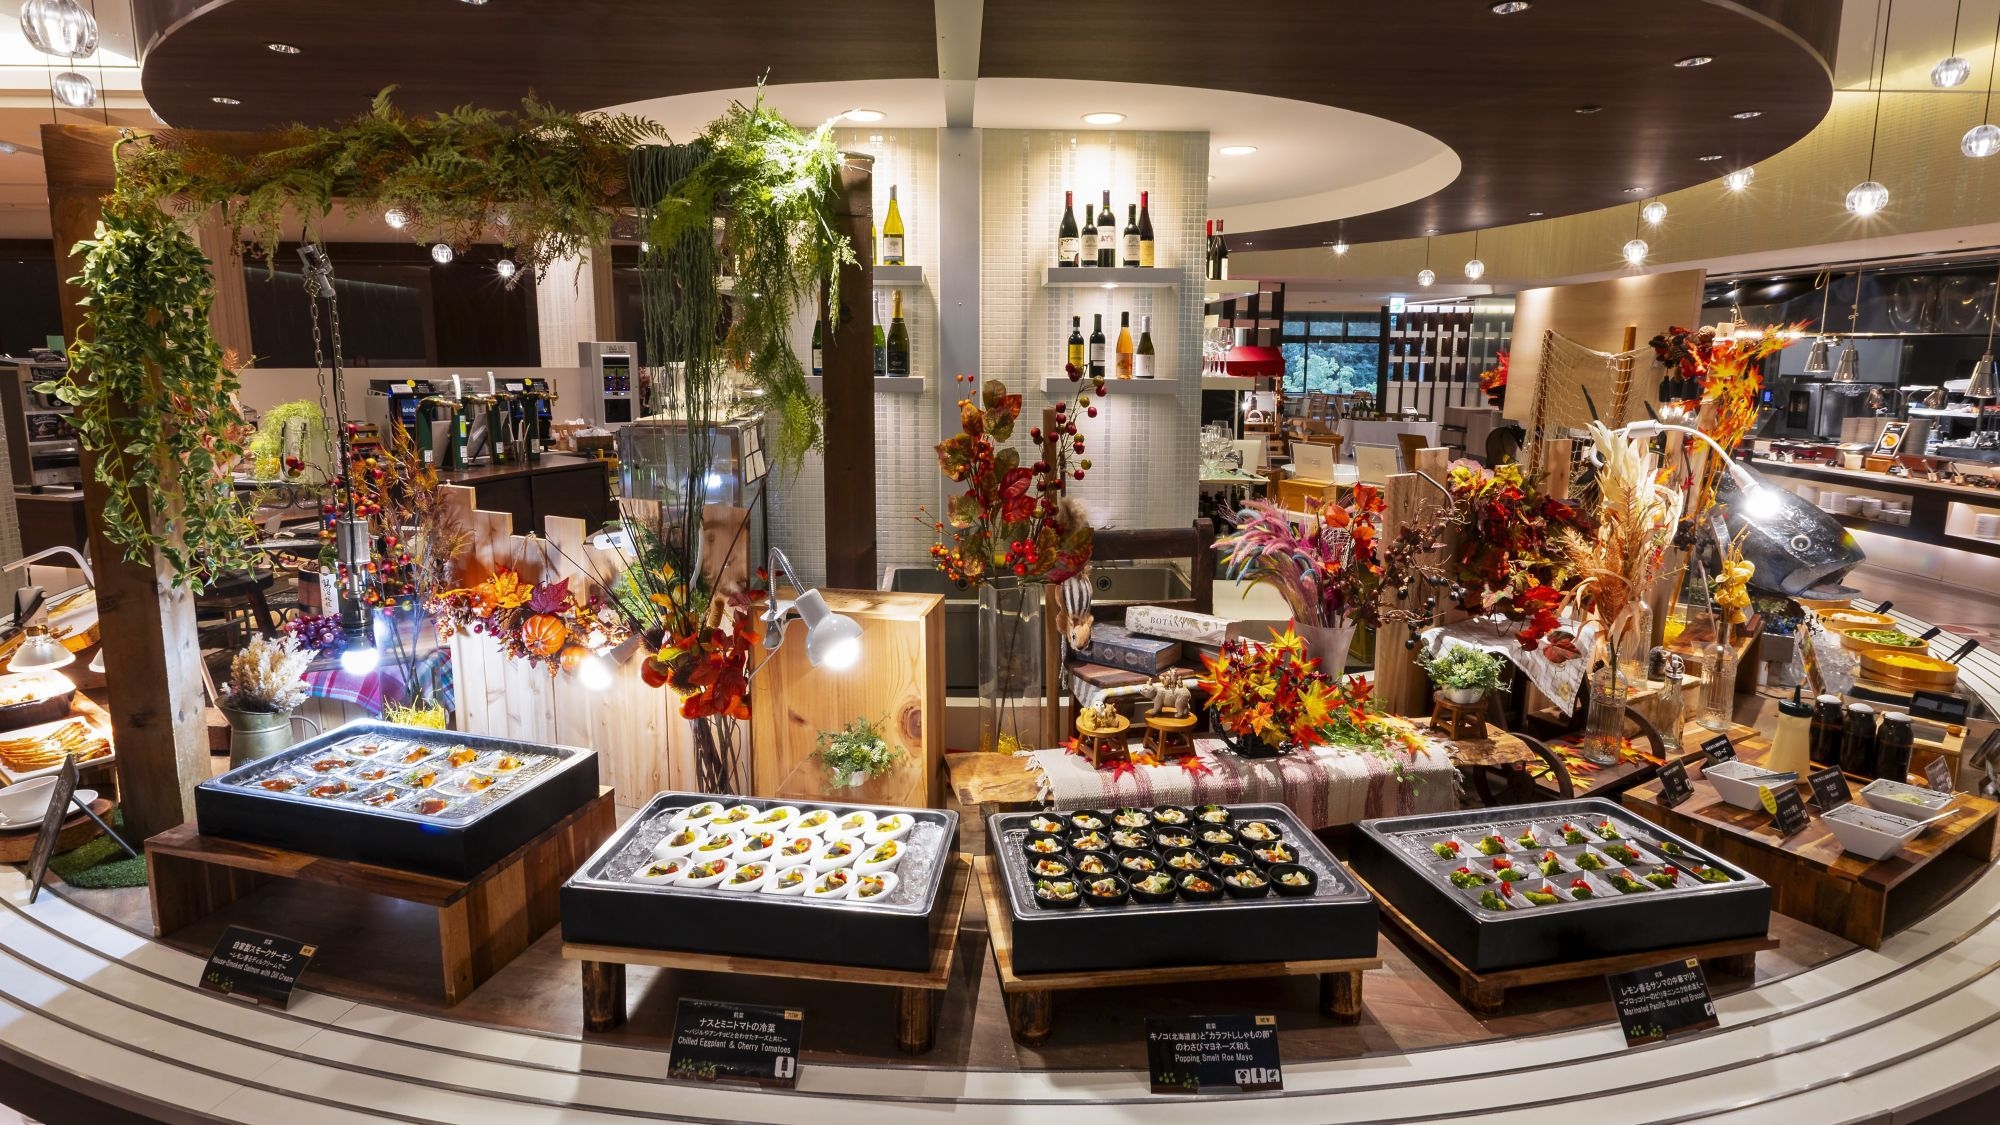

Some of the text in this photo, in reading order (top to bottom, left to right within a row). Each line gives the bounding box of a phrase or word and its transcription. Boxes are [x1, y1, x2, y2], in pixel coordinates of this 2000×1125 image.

[1150, 616, 1186, 629] BOTANY
[232, 941, 293, 962] 自家製スモークサーモン
[243, 964, 261, 974] Salmon
[260, 969, 271, 977] with
[270, 971, 279, 979] Dill
[278, 973, 294, 983] Cream
[1620, 972, 1697, 996] レモン香るサンマの中華マリネ
[1623, 990, 1706, 1016] Marinated Pacific Saury and Broccoli
[699, 1017, 776, 1033] ナスとミニトマトの冷菜
[678, 1035, 791, 1054] Chilled Eggplant & Cherry Tomatoes
[1175, 1042, 1250, 1051] のわさびマヨネーズ和え
[1175, 1053, 1200, 1063] Popping
[1202, 1054, 1220, 1062] Smelt
[1236, 1053, 1253, 1063] Mayo
